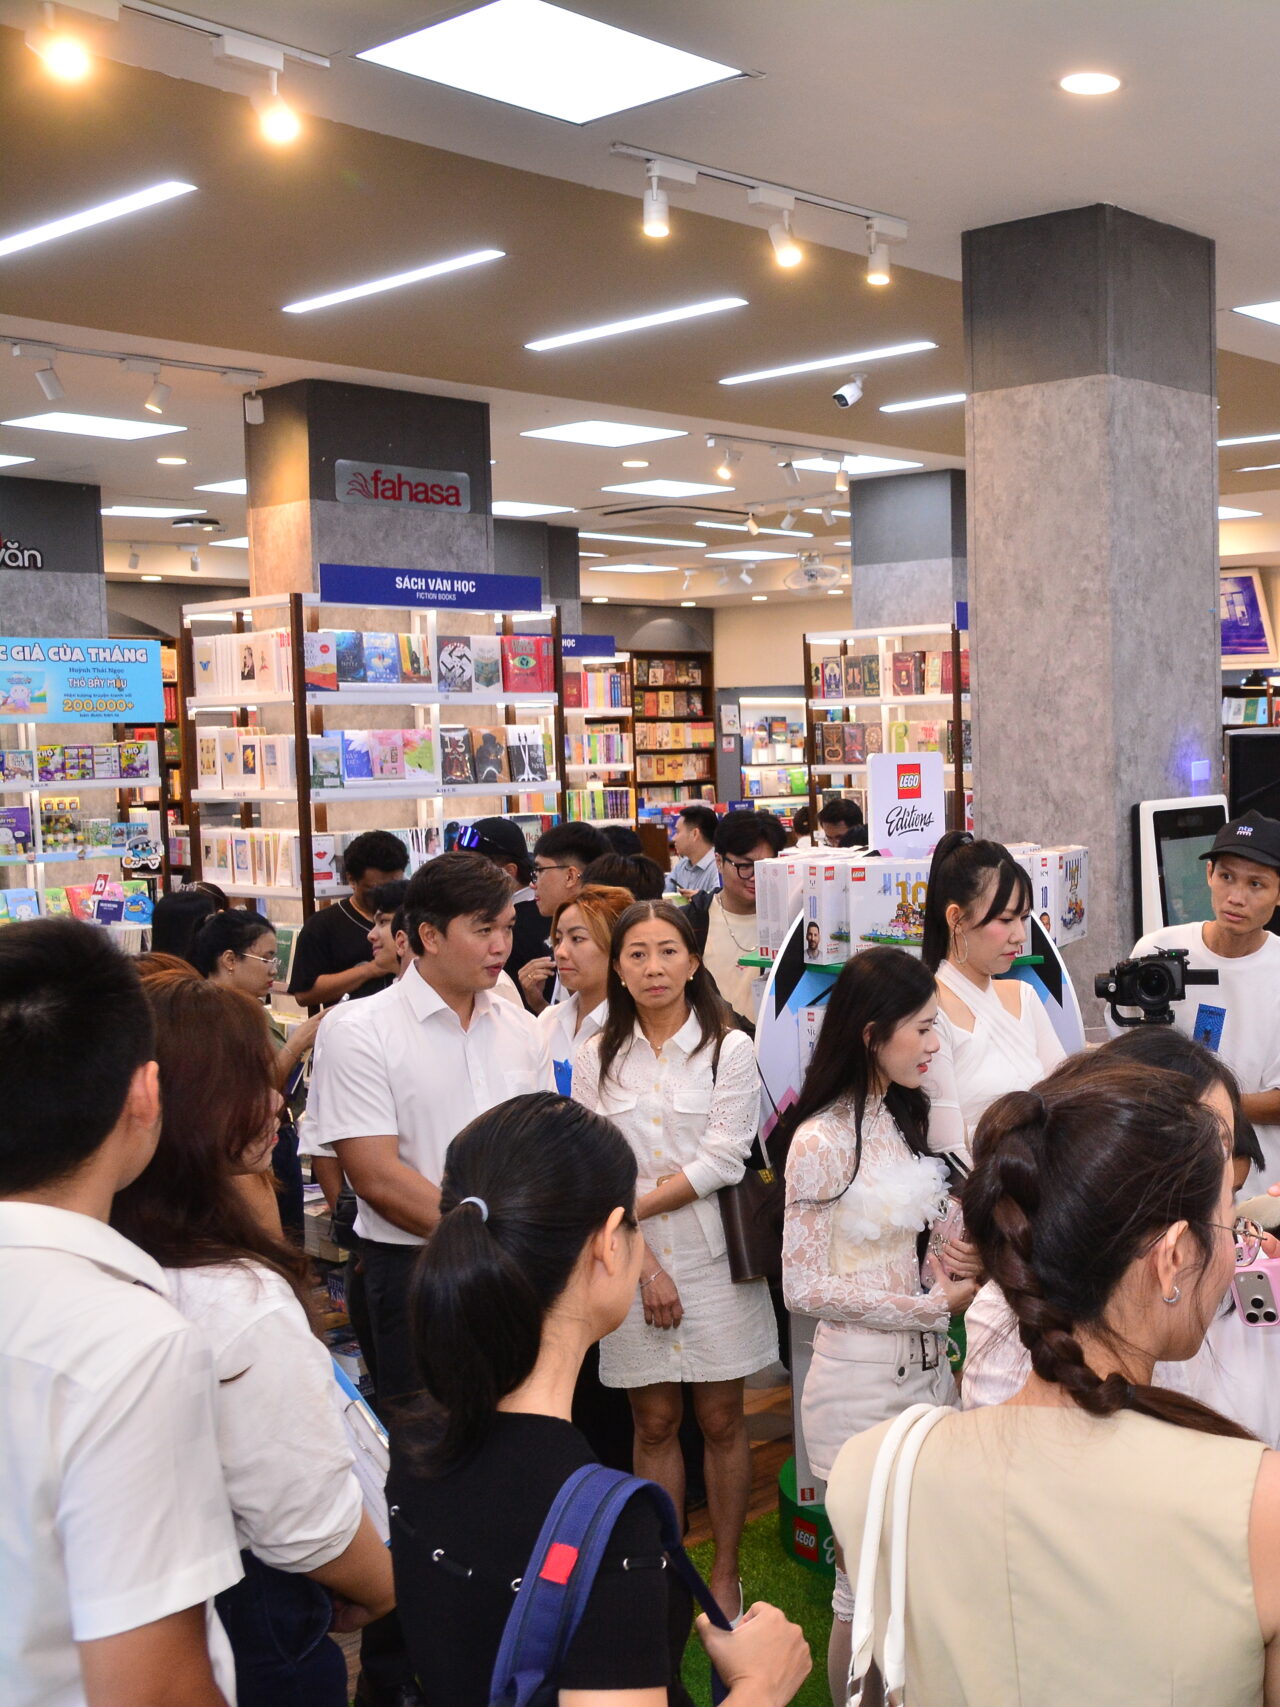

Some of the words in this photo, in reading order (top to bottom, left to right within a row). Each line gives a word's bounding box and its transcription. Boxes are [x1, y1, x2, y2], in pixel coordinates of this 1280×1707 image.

[371, 469, 462, 507] fahasa
[395, 574, 426, 590] SÁCH
[428, 577, 451, 592] VĂN
[454, 579, 476, 593] HỌC
[416, 592, 437, 600] FICTION
[438, 593, 457, 601] BOOKS
[48, 644, 85, 662] CỦA
[88, 645, 149, 663] THÁNG
[63, 698, 135, 713] 200.000+
[899, 773, 919, 788] LEGO
[885, 805, 934, 837] Editions
[795, 1529, 815, 1548] LEGO
